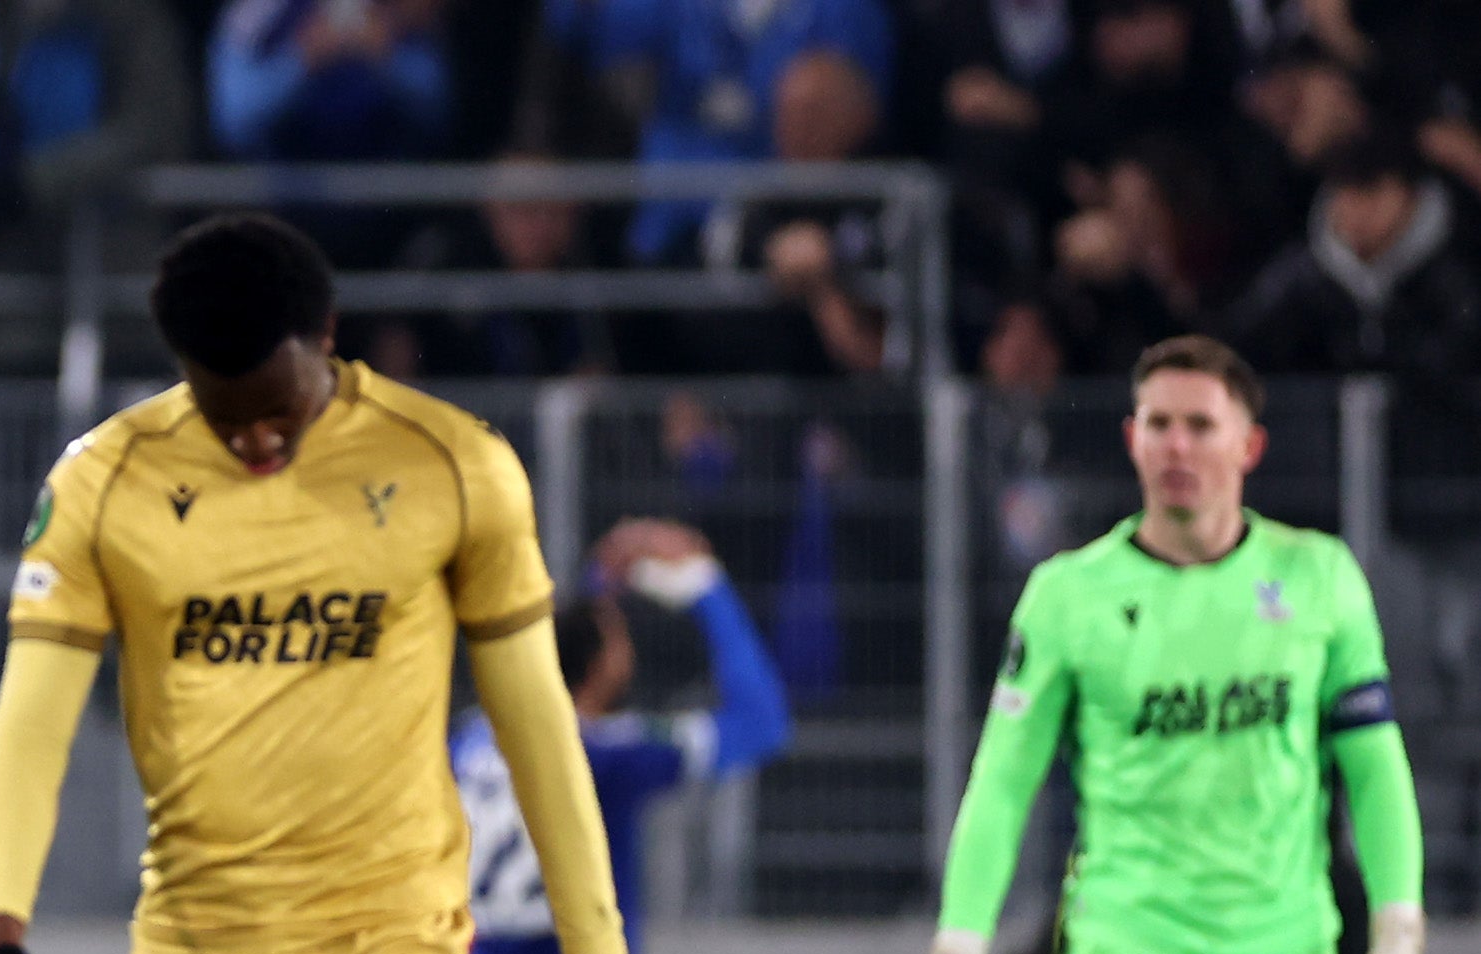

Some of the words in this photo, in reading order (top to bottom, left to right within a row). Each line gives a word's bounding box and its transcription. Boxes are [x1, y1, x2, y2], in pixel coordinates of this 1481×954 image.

[186, 592, 387, 625] PALACE
[173, 628, 267, 663] FOR
[276, 625, 384, 662] LIFE
